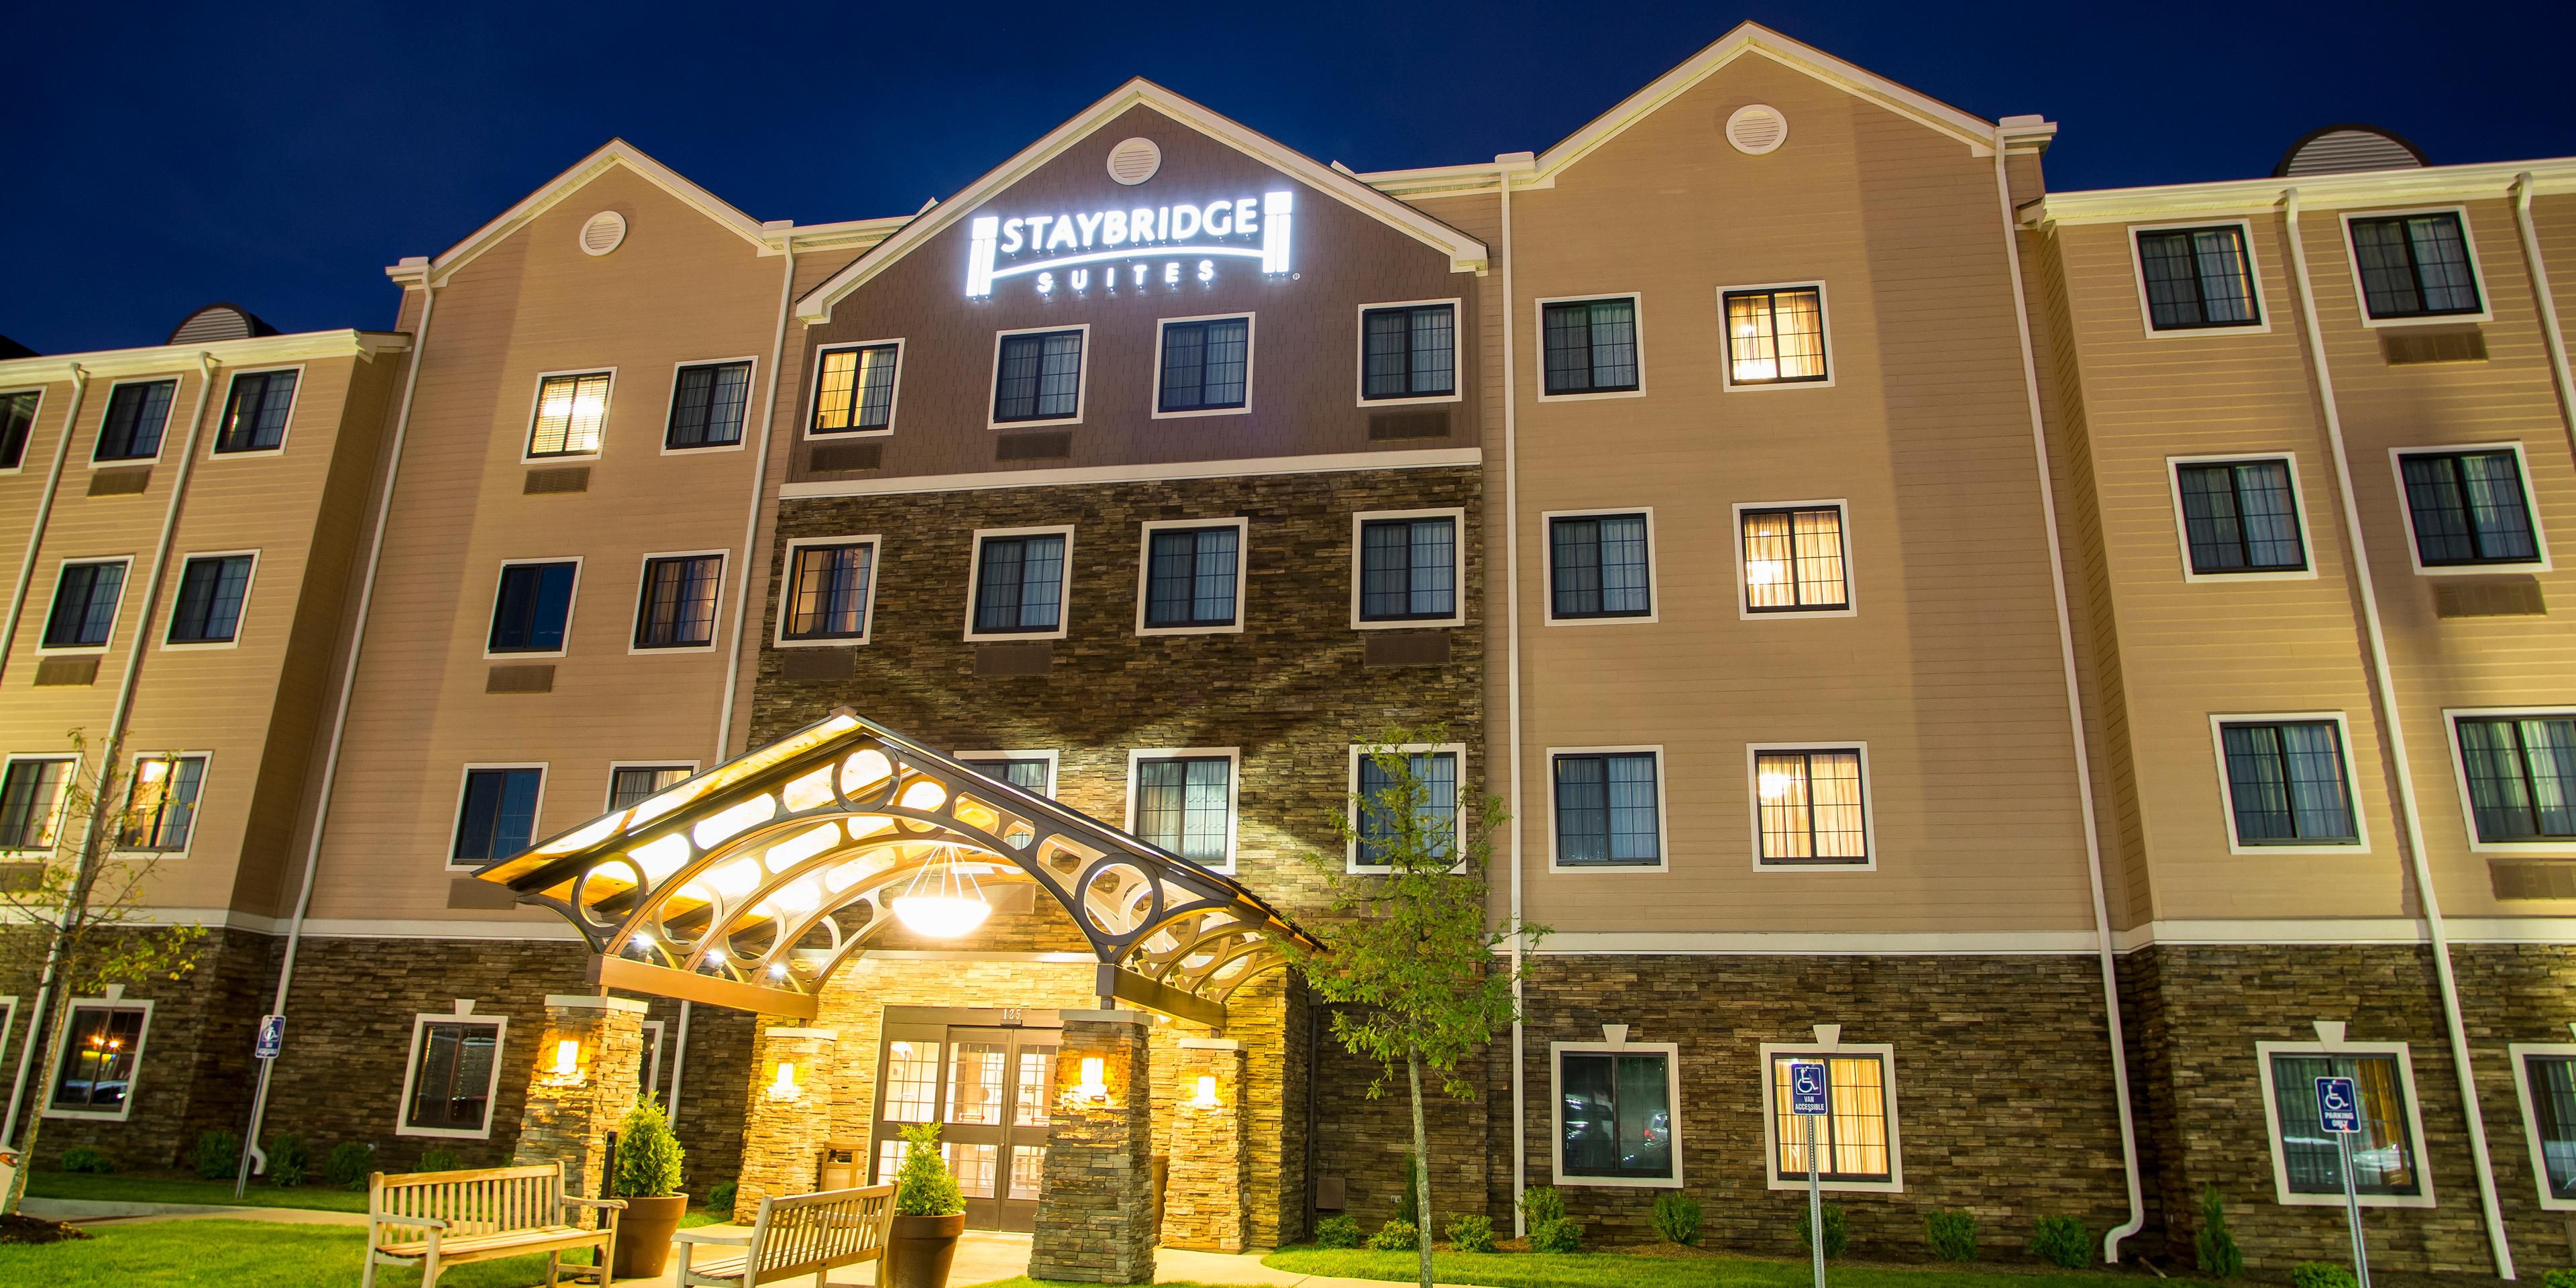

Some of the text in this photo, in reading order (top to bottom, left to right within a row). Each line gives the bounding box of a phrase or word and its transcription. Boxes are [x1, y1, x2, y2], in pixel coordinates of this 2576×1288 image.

[1001, 199, 1258, 252] STAYBRIDGE
[1037, 260, 1214, 293] SUITES
[1004, 1008, 1020, 1020] 125
